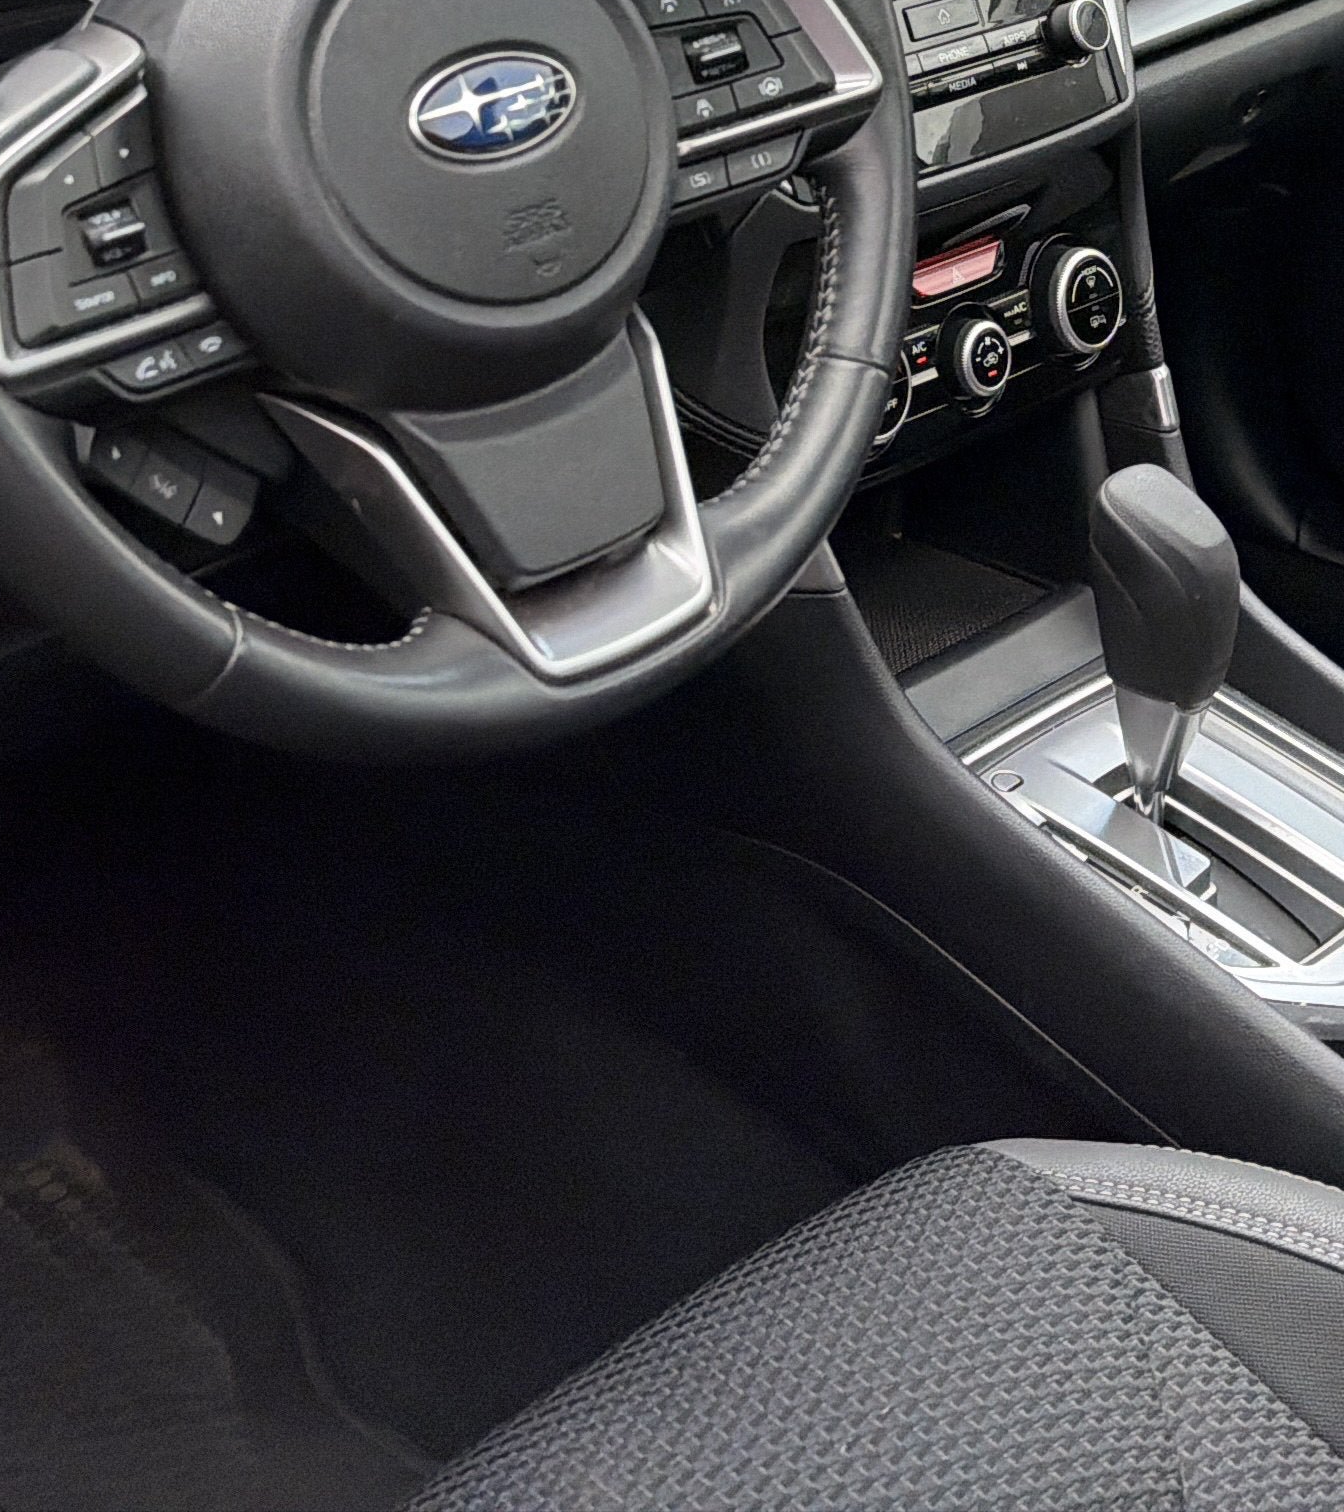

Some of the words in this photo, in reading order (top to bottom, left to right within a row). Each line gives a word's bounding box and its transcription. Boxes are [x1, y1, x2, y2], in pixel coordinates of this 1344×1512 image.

[1003, 30, 1027, 45] APPS
[938, 45, 970, 64] PHONE
[949, 76, 977, 93] MEDIA
[1014, 301, 1027, 315] A/C
[911, 340, 928, 356] A/C
